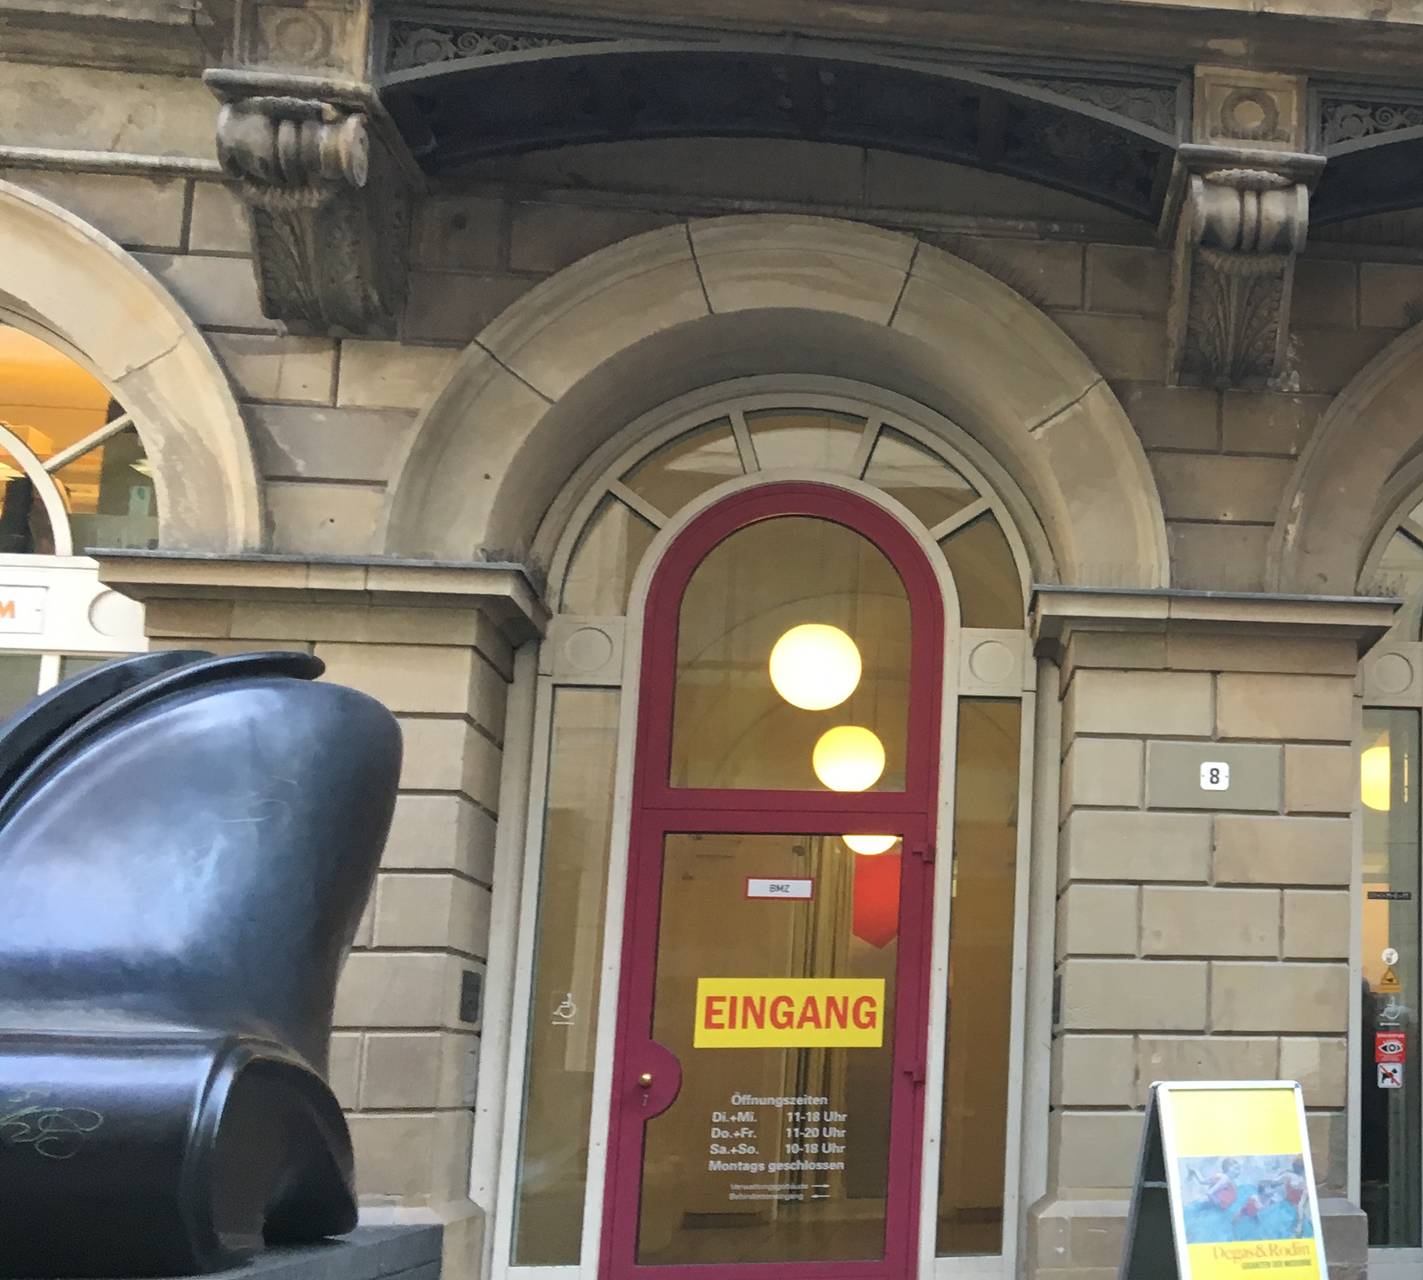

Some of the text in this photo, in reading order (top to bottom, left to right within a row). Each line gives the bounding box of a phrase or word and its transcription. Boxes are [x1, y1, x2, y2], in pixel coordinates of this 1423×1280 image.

[1209, 767, 1220, 785] 8
[703, 995, 878, 1030] EINGANG
[730, 1092, 828, 1108] Öffnungszeiten
[711, 1111, 847, 1123] Di.+Mi. 11-18 Uhr
[710, 1127, 847, 1138] Do.+Fr. 11-20 Uhr
[709, 1143, 846, 1154] Sa.+So. 10-18 Uhr
[708, 1160, 845, 1173] Montags geschlossen
